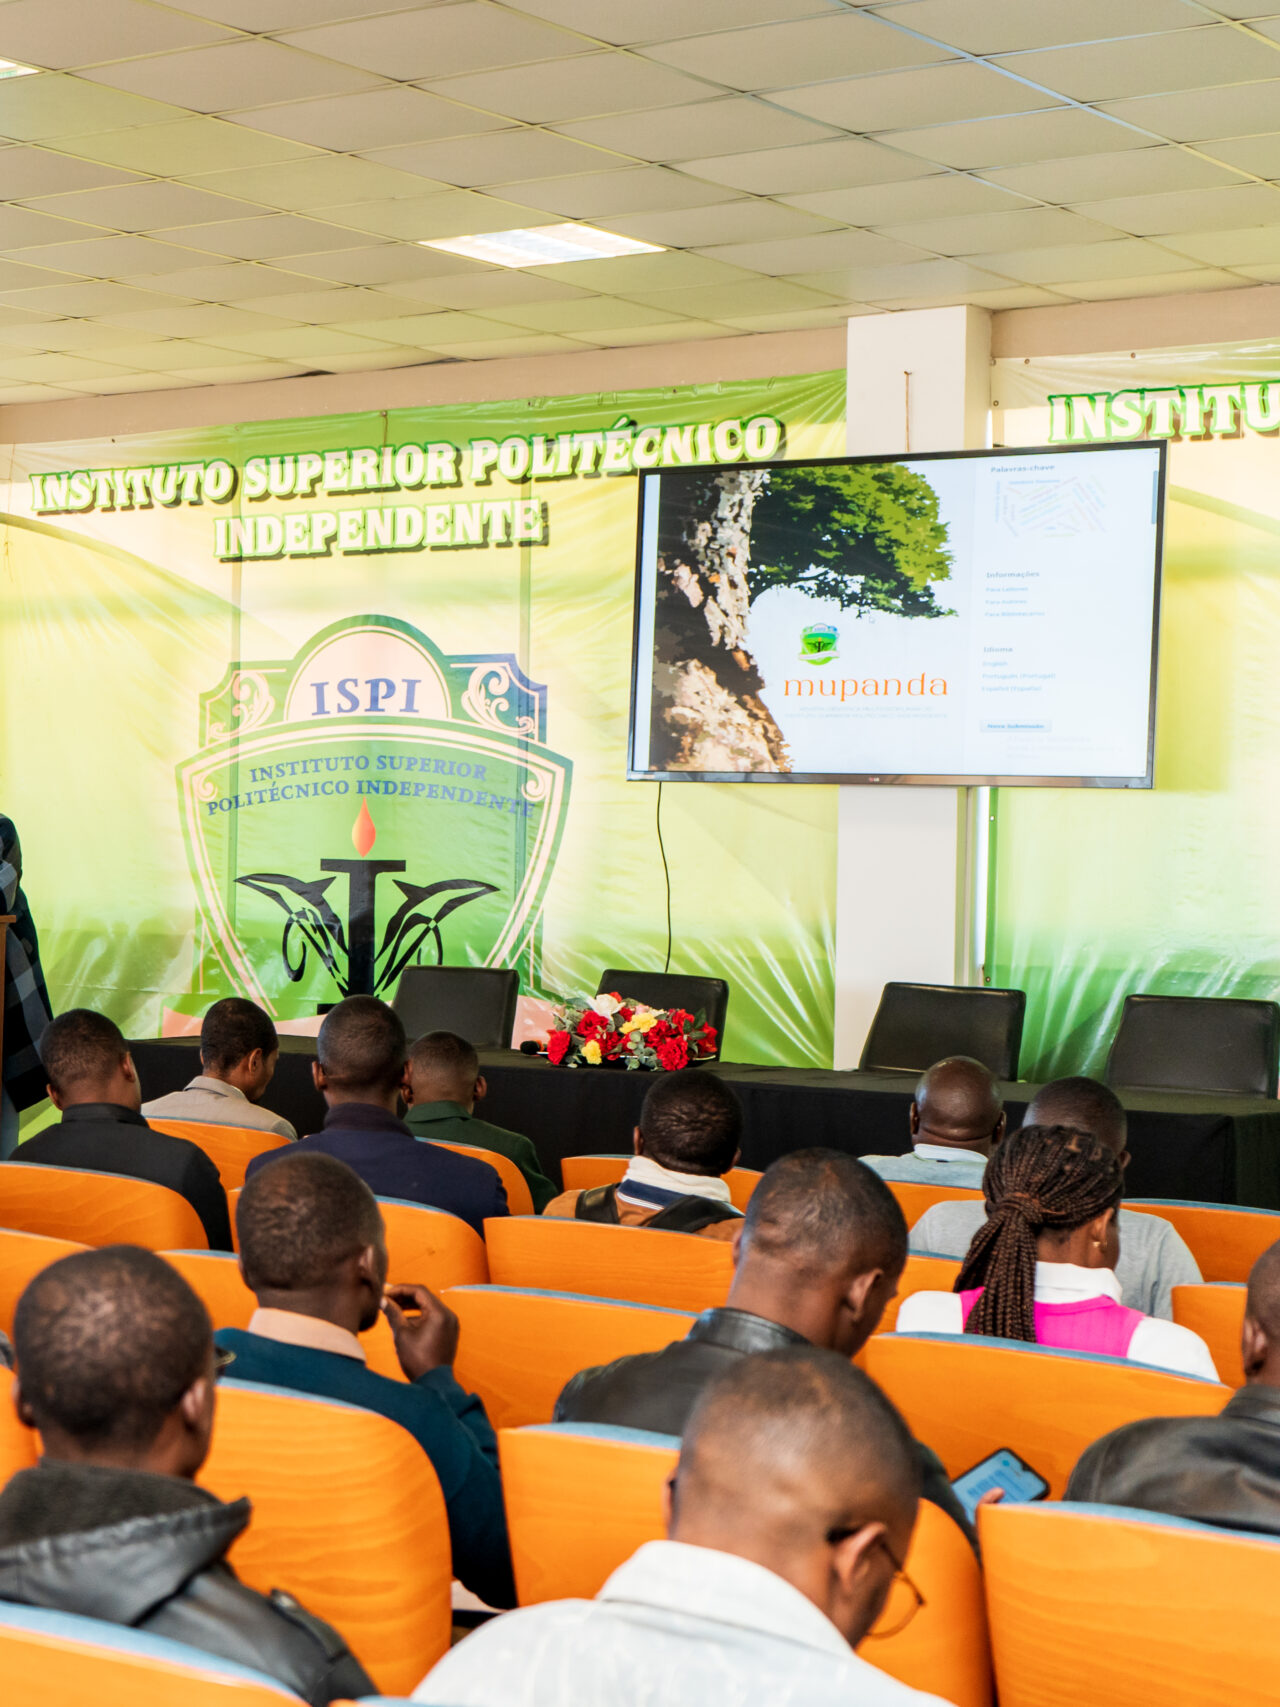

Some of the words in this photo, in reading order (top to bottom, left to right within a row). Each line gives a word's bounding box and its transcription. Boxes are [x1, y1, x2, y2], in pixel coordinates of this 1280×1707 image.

[30, 461, 237, 514] INSTITUTO
[243, 440, 460, 499] SUPERIOR
[469, 414, 784, 482] POLITÉCNICO
[213, 498, 546, 560] INDEPENDENTE
[310, 678, 422, 716] ISPI
[784, 672, 948, 702] mupanda
[249, 755, 370, 783] INSTITUTO
[376, 755, 487, 781] SUPERIOR
[206, 780, 350, 816] POLITÉCNICO
[356, 780, 536, 818] INDEPENDENTE
